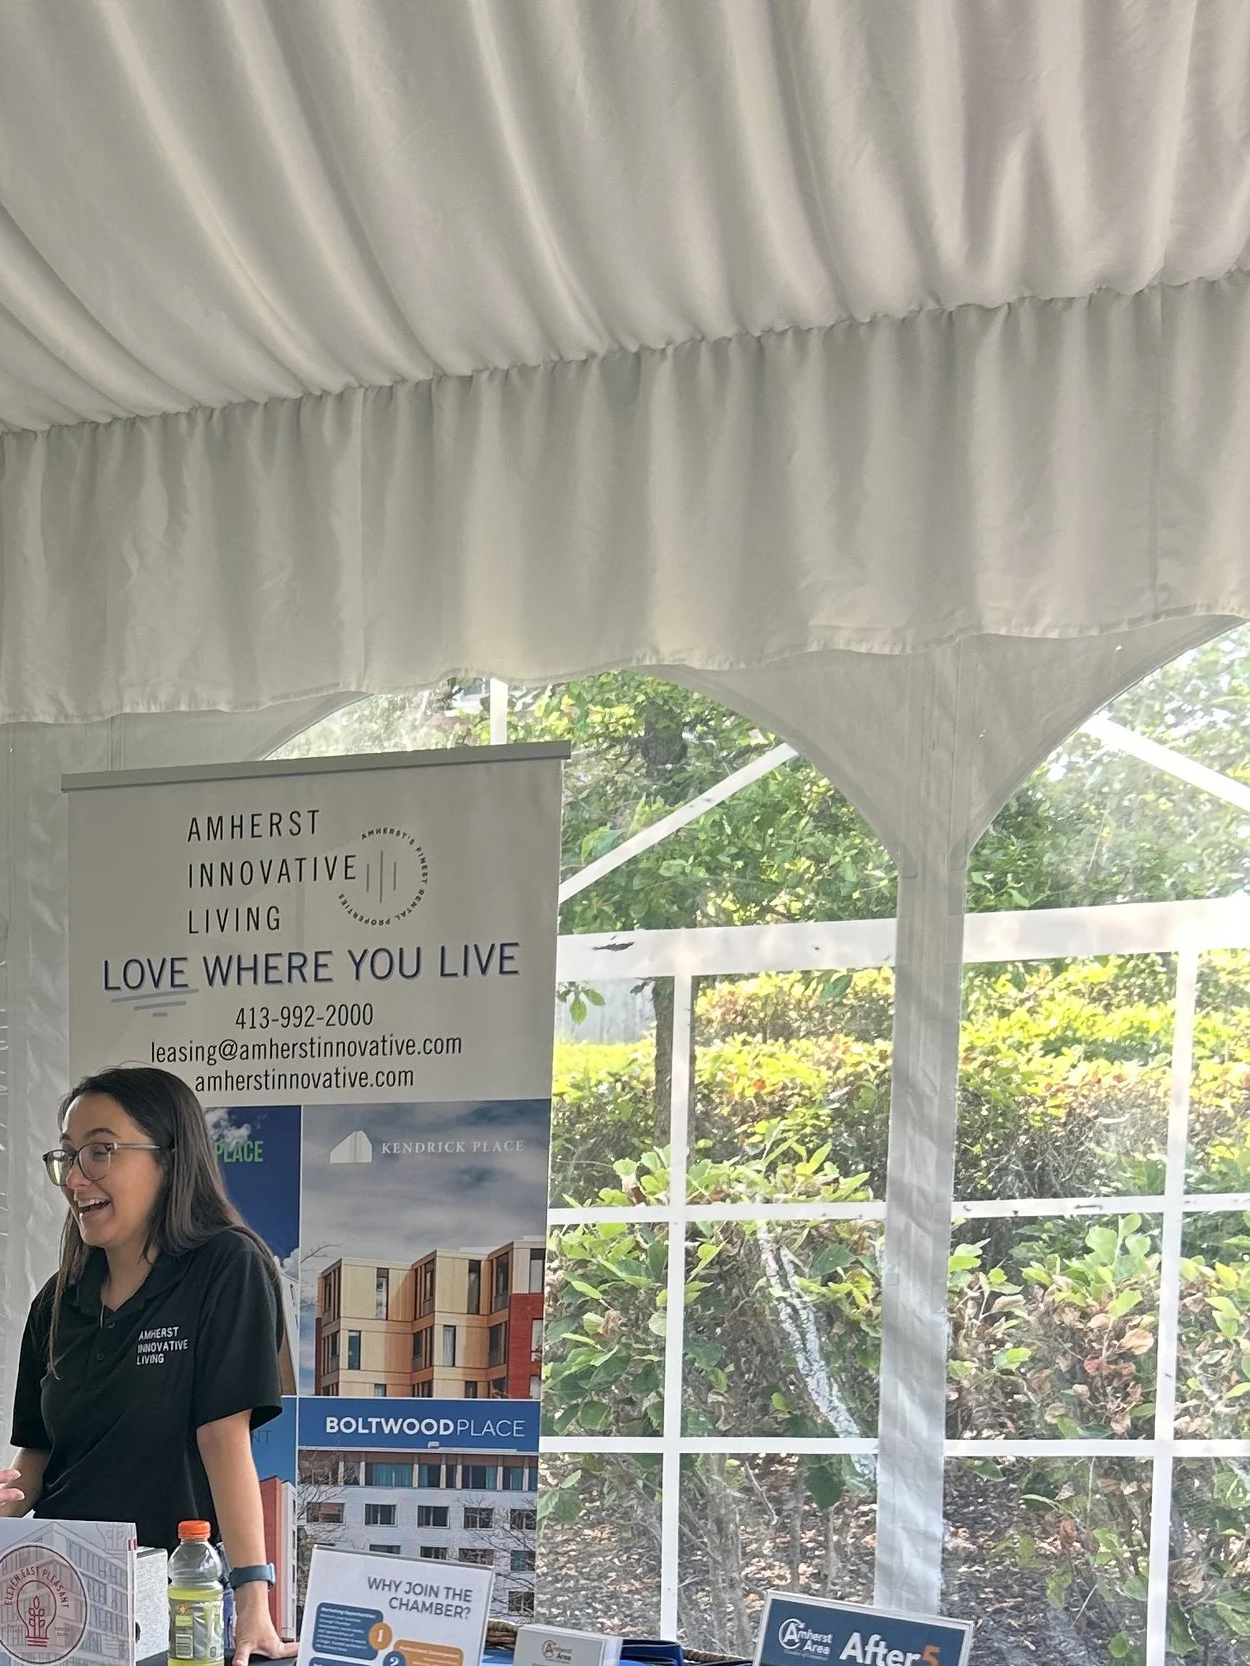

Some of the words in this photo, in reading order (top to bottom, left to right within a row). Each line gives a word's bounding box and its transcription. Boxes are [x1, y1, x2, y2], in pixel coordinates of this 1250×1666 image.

[187, 809, 320, 843] AMHERST
[361, 827, 415, 846] AMHERST'S
[188, 854, 357, 888] INNOVATIVE
[415, 847, 428, 884] FINEST
[338, 893, 390, 926] PROPERTIES
[395, 889, 425, 920] RENTAL
[188, 905, 281, 934] LIVING
[103, 956, 189, 992] LOVE
[203, 950, 334, 987] WHERE
[348, 946, 423, 982] YOU
[439, 942, 520, 978] LIVE
[235, 1003, 374, 1030] 413-992-2000
[150, 1034, 462, 1067] leasing@amherstinnovative.com
[195, 1068, 414, 1094] amherstinnovative.com
[381, 1141, 467, 1156] KENDRICK
[472, 1139, 525, 1153] PLACE
[137, 1339, 188, 1354] INNOVATIVE
[138, 1326, 179, 1341] AMHERST
[136, 1353, 165, 1365] LIVING
[5, 1574, 21, 1606] ELEVEN
[20, 1566, 40, 1579] EAST
[42, 1568, 70, 1609] PLEASANT
[367, 1576, 401, 1593] WHY
[404, 1581, 441, 1598] JOIN
[444, 1586, 472, 1603] THE
[389, 1597, 472, 1620] CHAMBER?
[377, 1629, 384, 1642] 1
[783, 1623, 832, 1643] Amherst
[803, 1641, 829, 1655] Area
